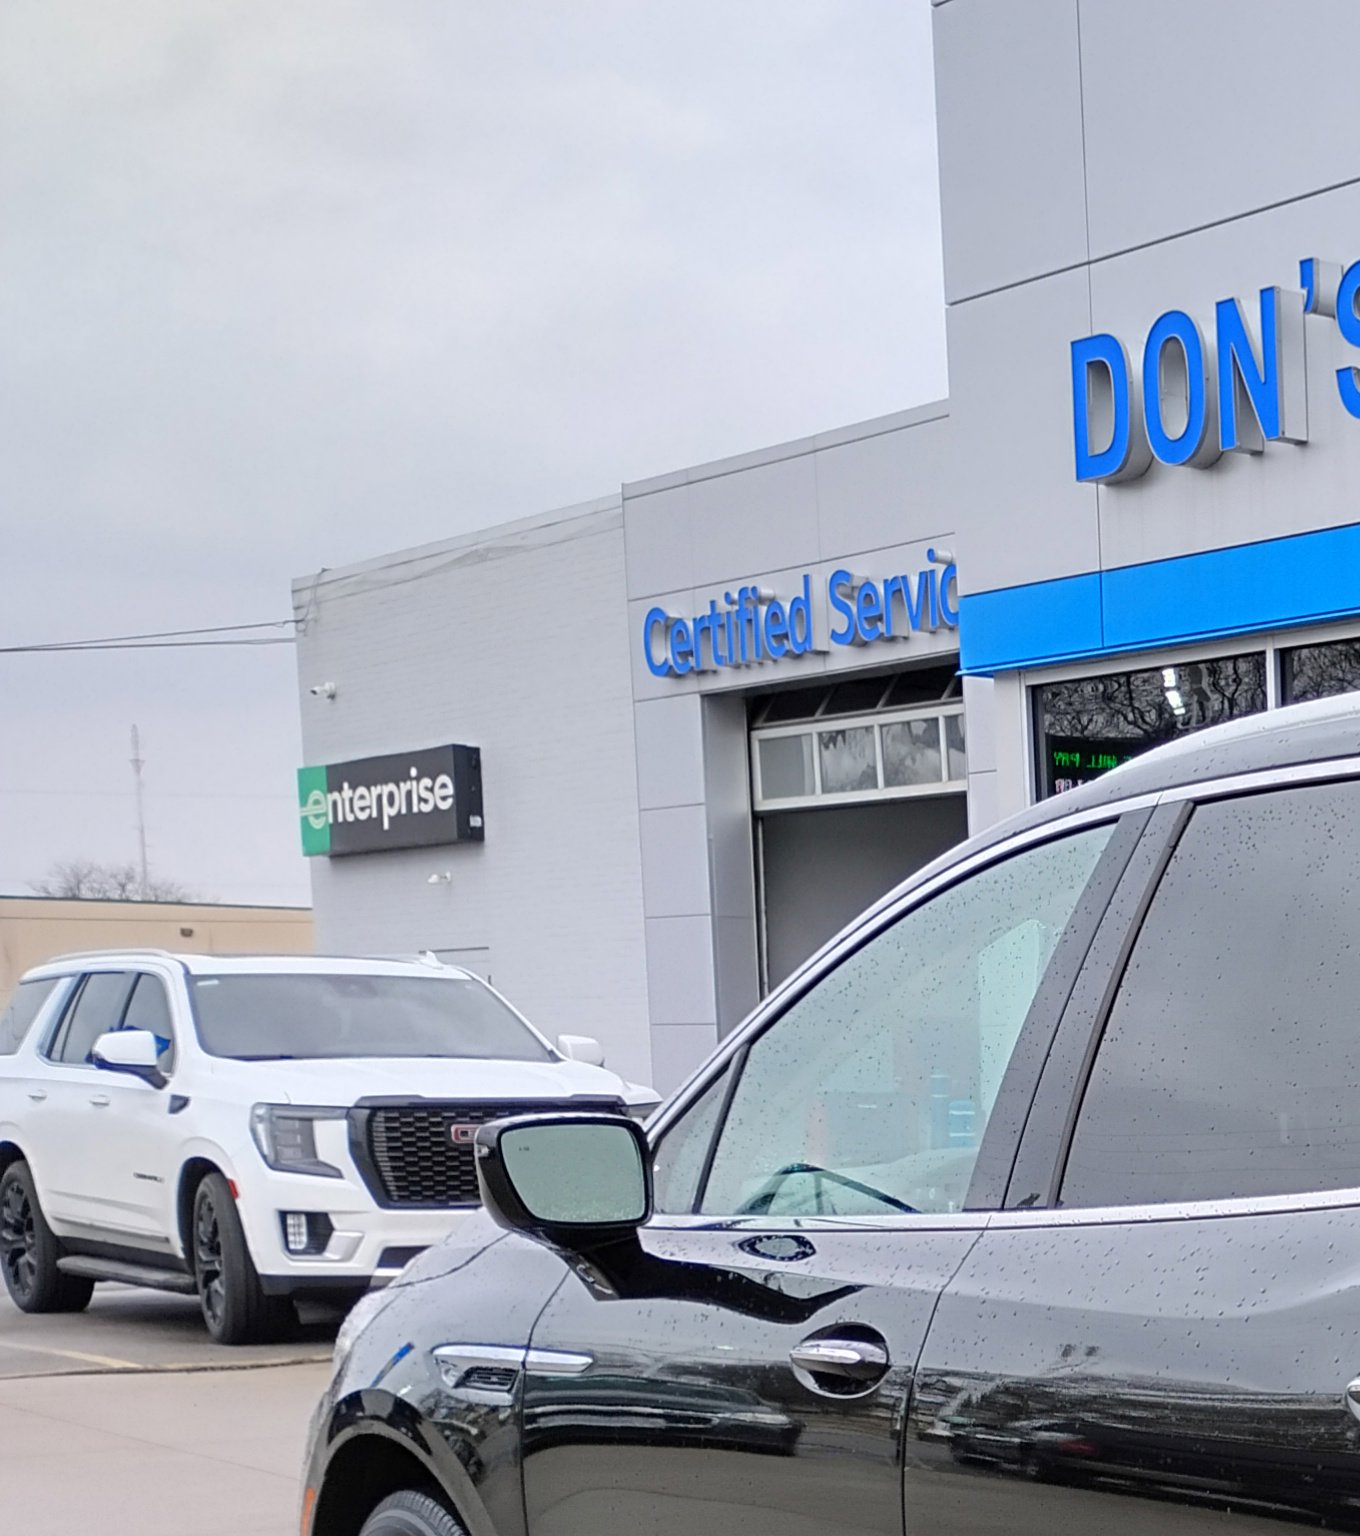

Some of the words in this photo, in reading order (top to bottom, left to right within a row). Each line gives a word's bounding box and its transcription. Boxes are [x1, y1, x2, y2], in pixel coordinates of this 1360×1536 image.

[643, 574, 815, 678] Certified
[828, 547, 959, 647] Servic
[300, 766, 455, 831] enterprise
